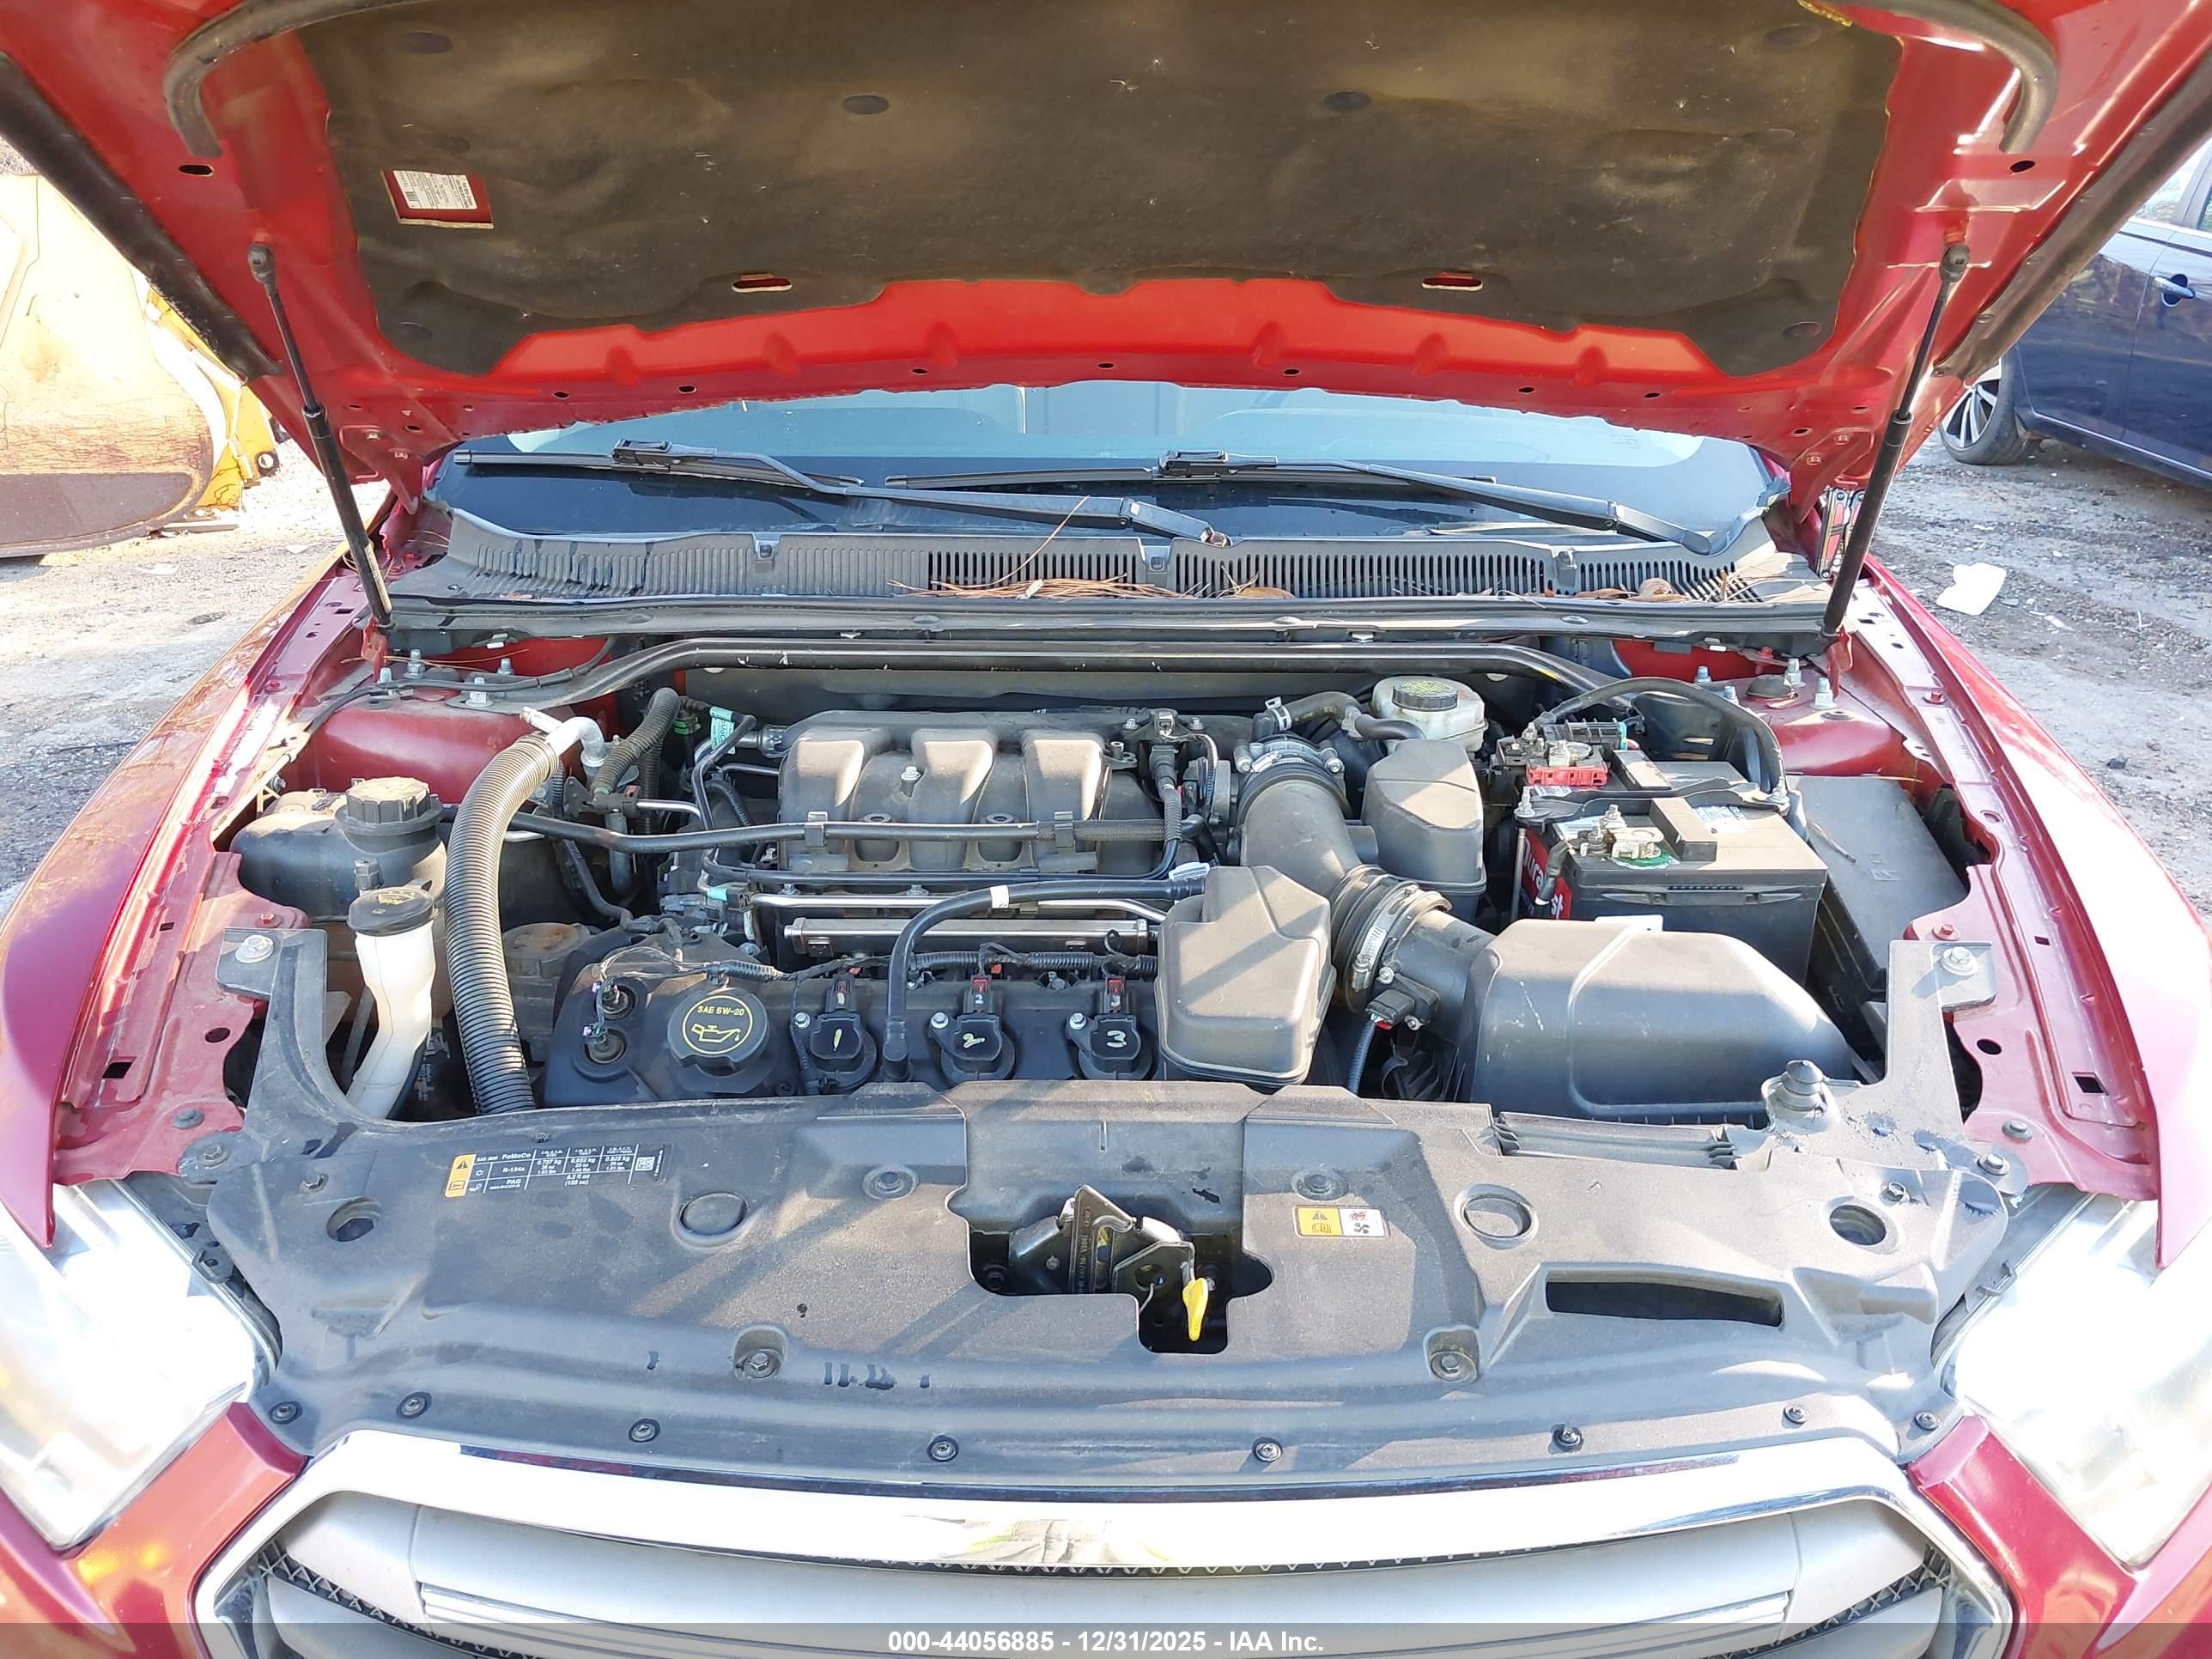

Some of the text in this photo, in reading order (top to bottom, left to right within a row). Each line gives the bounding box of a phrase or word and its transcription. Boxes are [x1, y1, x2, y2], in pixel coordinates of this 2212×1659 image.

[1524, 838, 1564, 920] Durast
[975, 994, 984, 1005] 2
[696, 1006, 745, 1017] SAE 5W-20
[963, 1032, 986, 1049] 2
[1106, 1030, 1127, 1048] 3
